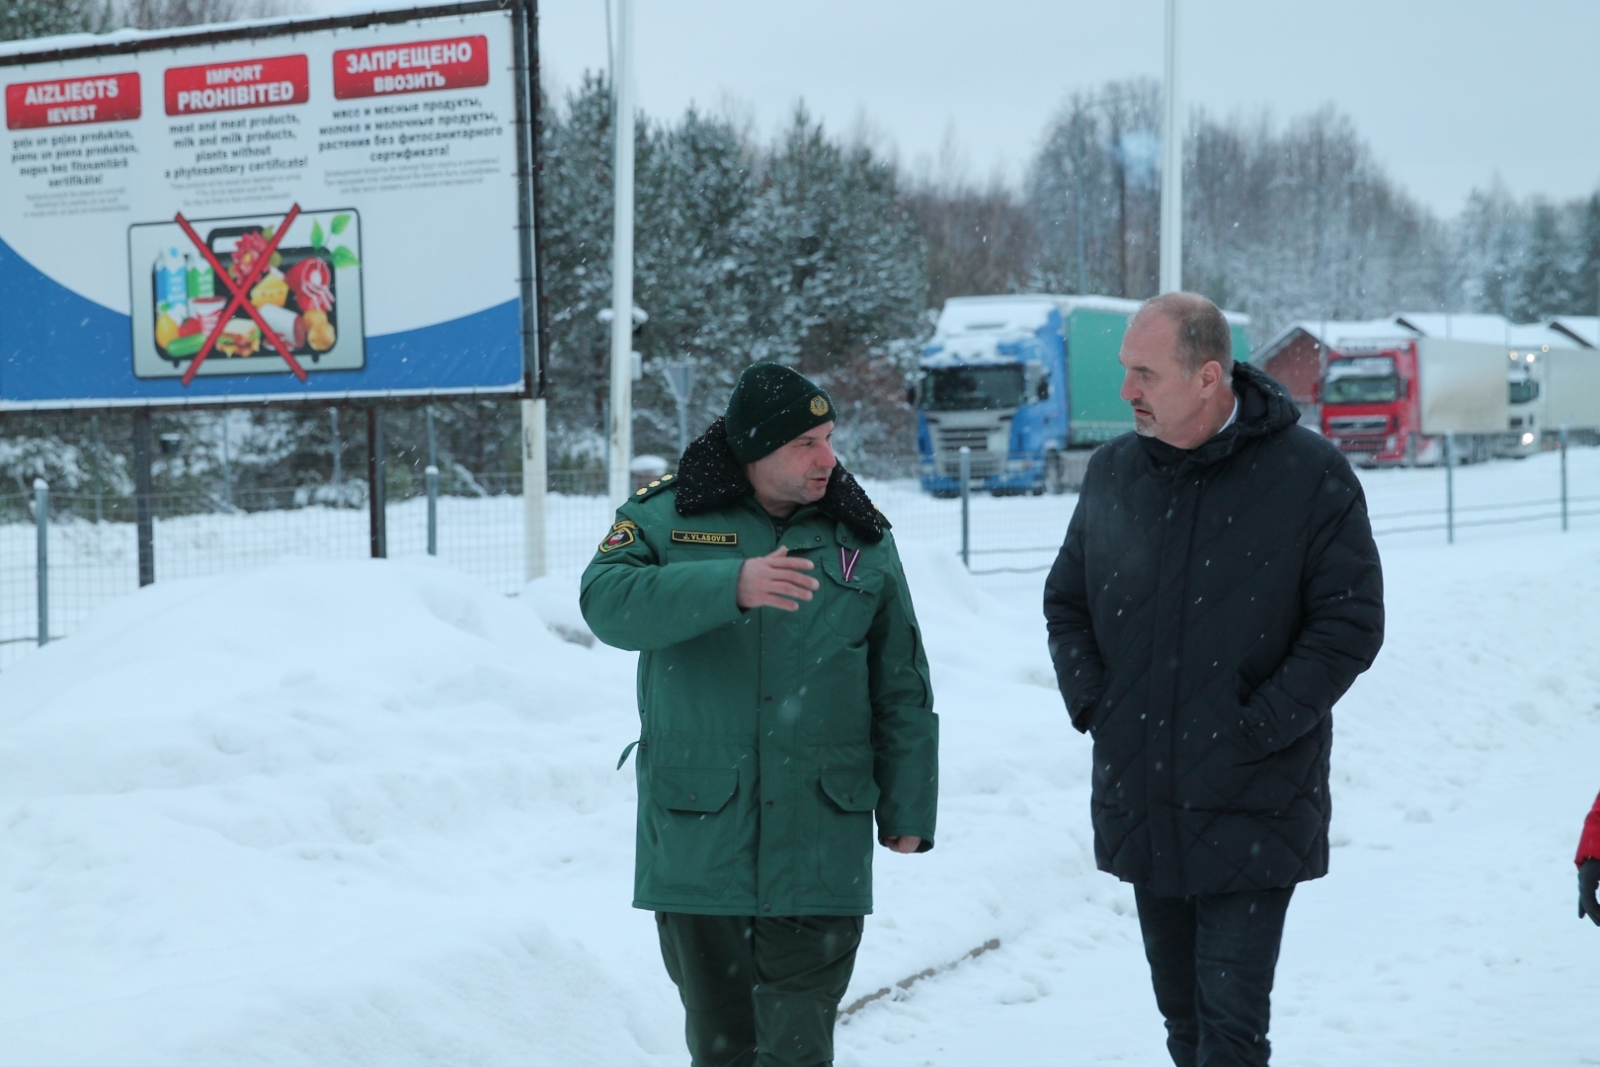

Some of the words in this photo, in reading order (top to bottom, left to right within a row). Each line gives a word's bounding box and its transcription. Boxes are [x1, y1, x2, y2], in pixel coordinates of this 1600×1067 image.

[346, 42, 472, 74] ЗАПРЕЩЕНО
[206, 64, 263, 85] IMPORT
[373, 72, 446, 93] ВВОЗИТЬ
[25, 79, 119, 106] AIZLIEGTS
[177, 81, 294, 111] PROHIBITED
[47, 105, 97, 123] IEVEST
[332, 107, 360, 119] мясо
[365, 107, 370, 116] и
[375, 103, 419, 116] мясные
[423, 97, 482, 113] продукты,
[169, 123, 194, 134] meat
[198, 120, 216, 131] and
[220, 118, 246, 130] meat
[250, 113, 300, 128] products,
[319, 122, 360, 135] молоко
[365, 122, 372, 131] и
[375, 117, 434, 131] молочные
[438, 112, 498, 128] продукты,
[36, 136, 48, 146] un
[174, 135, 195, 148] milk
[200, 133, 217, 145] and
[221, 131, 242, 144] milk
[246, 129, 297, 143] products,
[318, 136, 370, 153] растения
[374, 133, 394, 146] без
[398, 126, 503, 146] фитосанитарного
[42, 150, 52, 160] un
[55, 147, 83, 161] piena
[195, 149, 227, 164] plants
[232, 145, 271, 158] without
[370, 145, 450, 161] сертификата!
[52, 162, 68, 174] bez
[165, 170, 170, 178] a
[174, 164, 245, 180] phytosanitary
[249, 156, 308, 171] certificate!
[691, 534, 726, 542] VLASOVS
